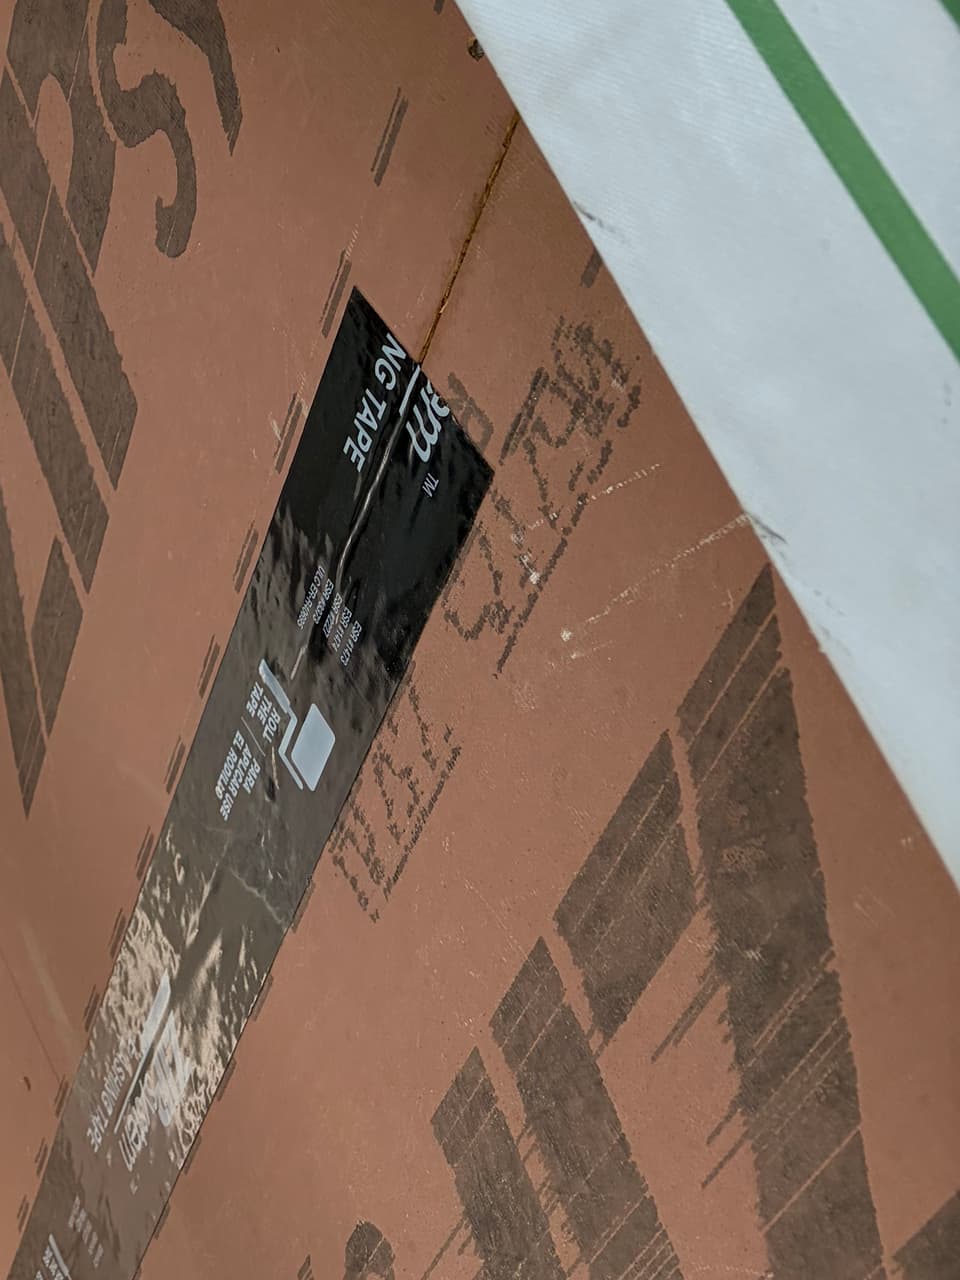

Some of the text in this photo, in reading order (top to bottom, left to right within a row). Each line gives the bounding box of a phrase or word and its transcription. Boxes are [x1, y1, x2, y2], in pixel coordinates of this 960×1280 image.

[343, 333, 407, 472] NG TAPE
[322, 578, 334, 601] ESR
[332, 592, 343, 614] ESR
[341, 606, 353, 629] ESR
[350, 620, 362, 642] ESR
[246, 681, 264, 718] TAPE
[257, 695, 272, 726] THE
[262, 707, 281, 743] ROLL
[215, 730, 244, 799] EL RODILLO
[220, 743, 252, 821] APLICAR USE
[242, 758, 261, 794] PARA
